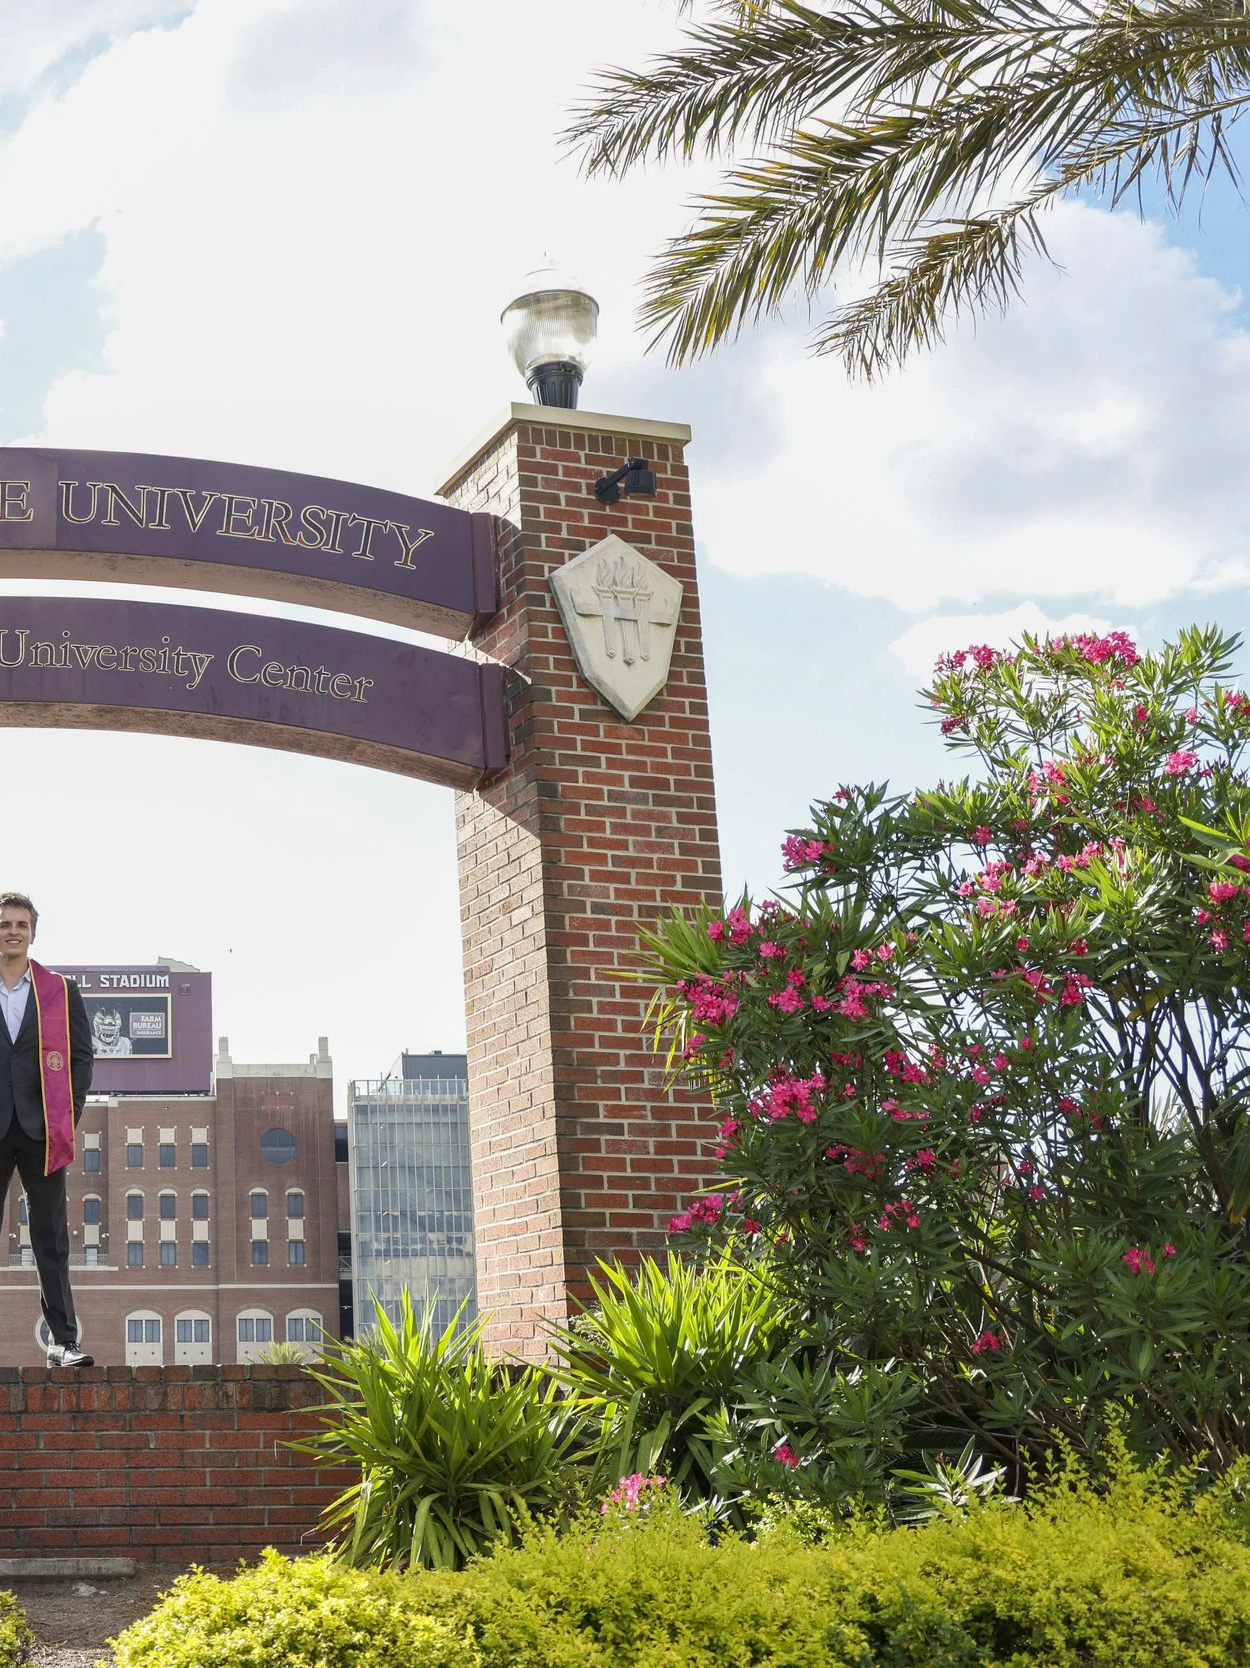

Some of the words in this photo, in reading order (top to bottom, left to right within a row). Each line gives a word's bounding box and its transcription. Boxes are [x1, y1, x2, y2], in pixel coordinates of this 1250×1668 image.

[59, 481, 435, 570] UNIVERSITY
[227, 645, 374, 703] Center
[99, 974, 170, 988] STADIUM
[141, 1015, 162, 1023] FARM
